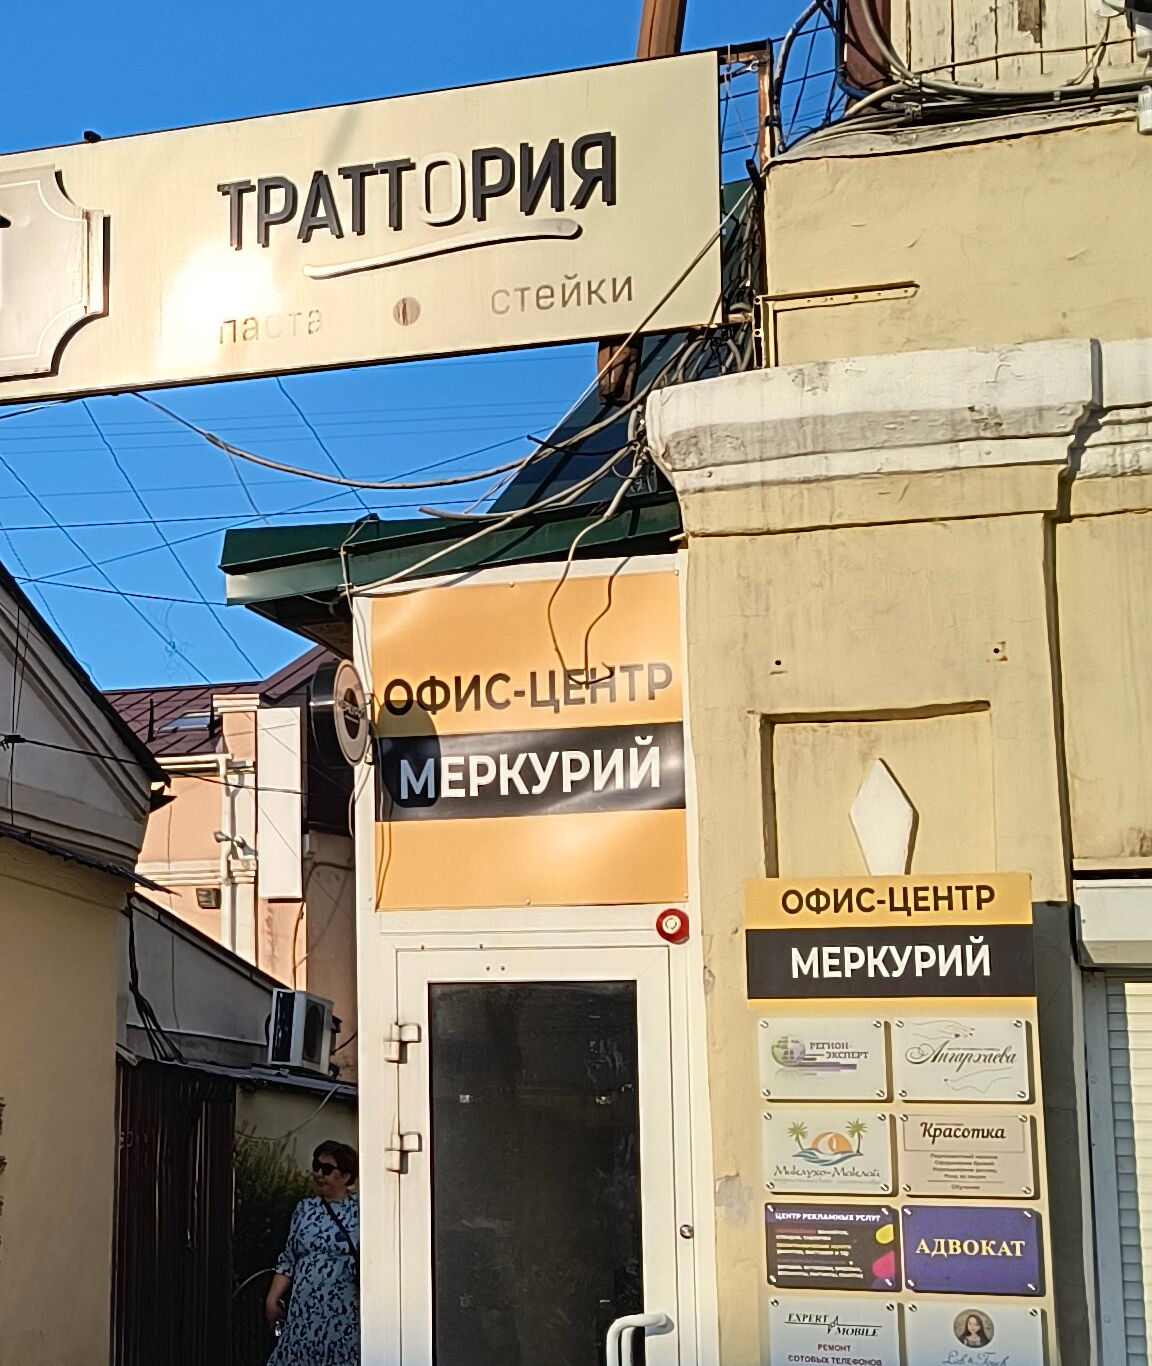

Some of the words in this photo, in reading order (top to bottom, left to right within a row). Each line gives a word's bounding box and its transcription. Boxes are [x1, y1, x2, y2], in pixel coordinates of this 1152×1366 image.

[218, 132, 618, 251] ТРАТТОРИЯ
[490, 274, 634, 316] стейки
[384, 662, 674, 716] ОФИС-ЦЕНТР
[399, 735, 661, 800] МЕРКУРИЙ
[780, 884, 996, 917] ОФИС-ЦЕНТР
[790, 935, 992, 980] МЕРКУРИЙ
[919, 1121, 1007, 1145] Красотка
[915, 1237, 1026, 1258] АДВОКАТ
[787, 1313, 829, 1323] EXPERT
[834, 1326, 880, 1337] MOBILE
[787, 1354, 830, 1364] СОТОВЫХ
[831, 1356, 883, 1366] ТЕЛЕФОНОВ
[817, 1343, 852, 1353] РЕМОНТ
